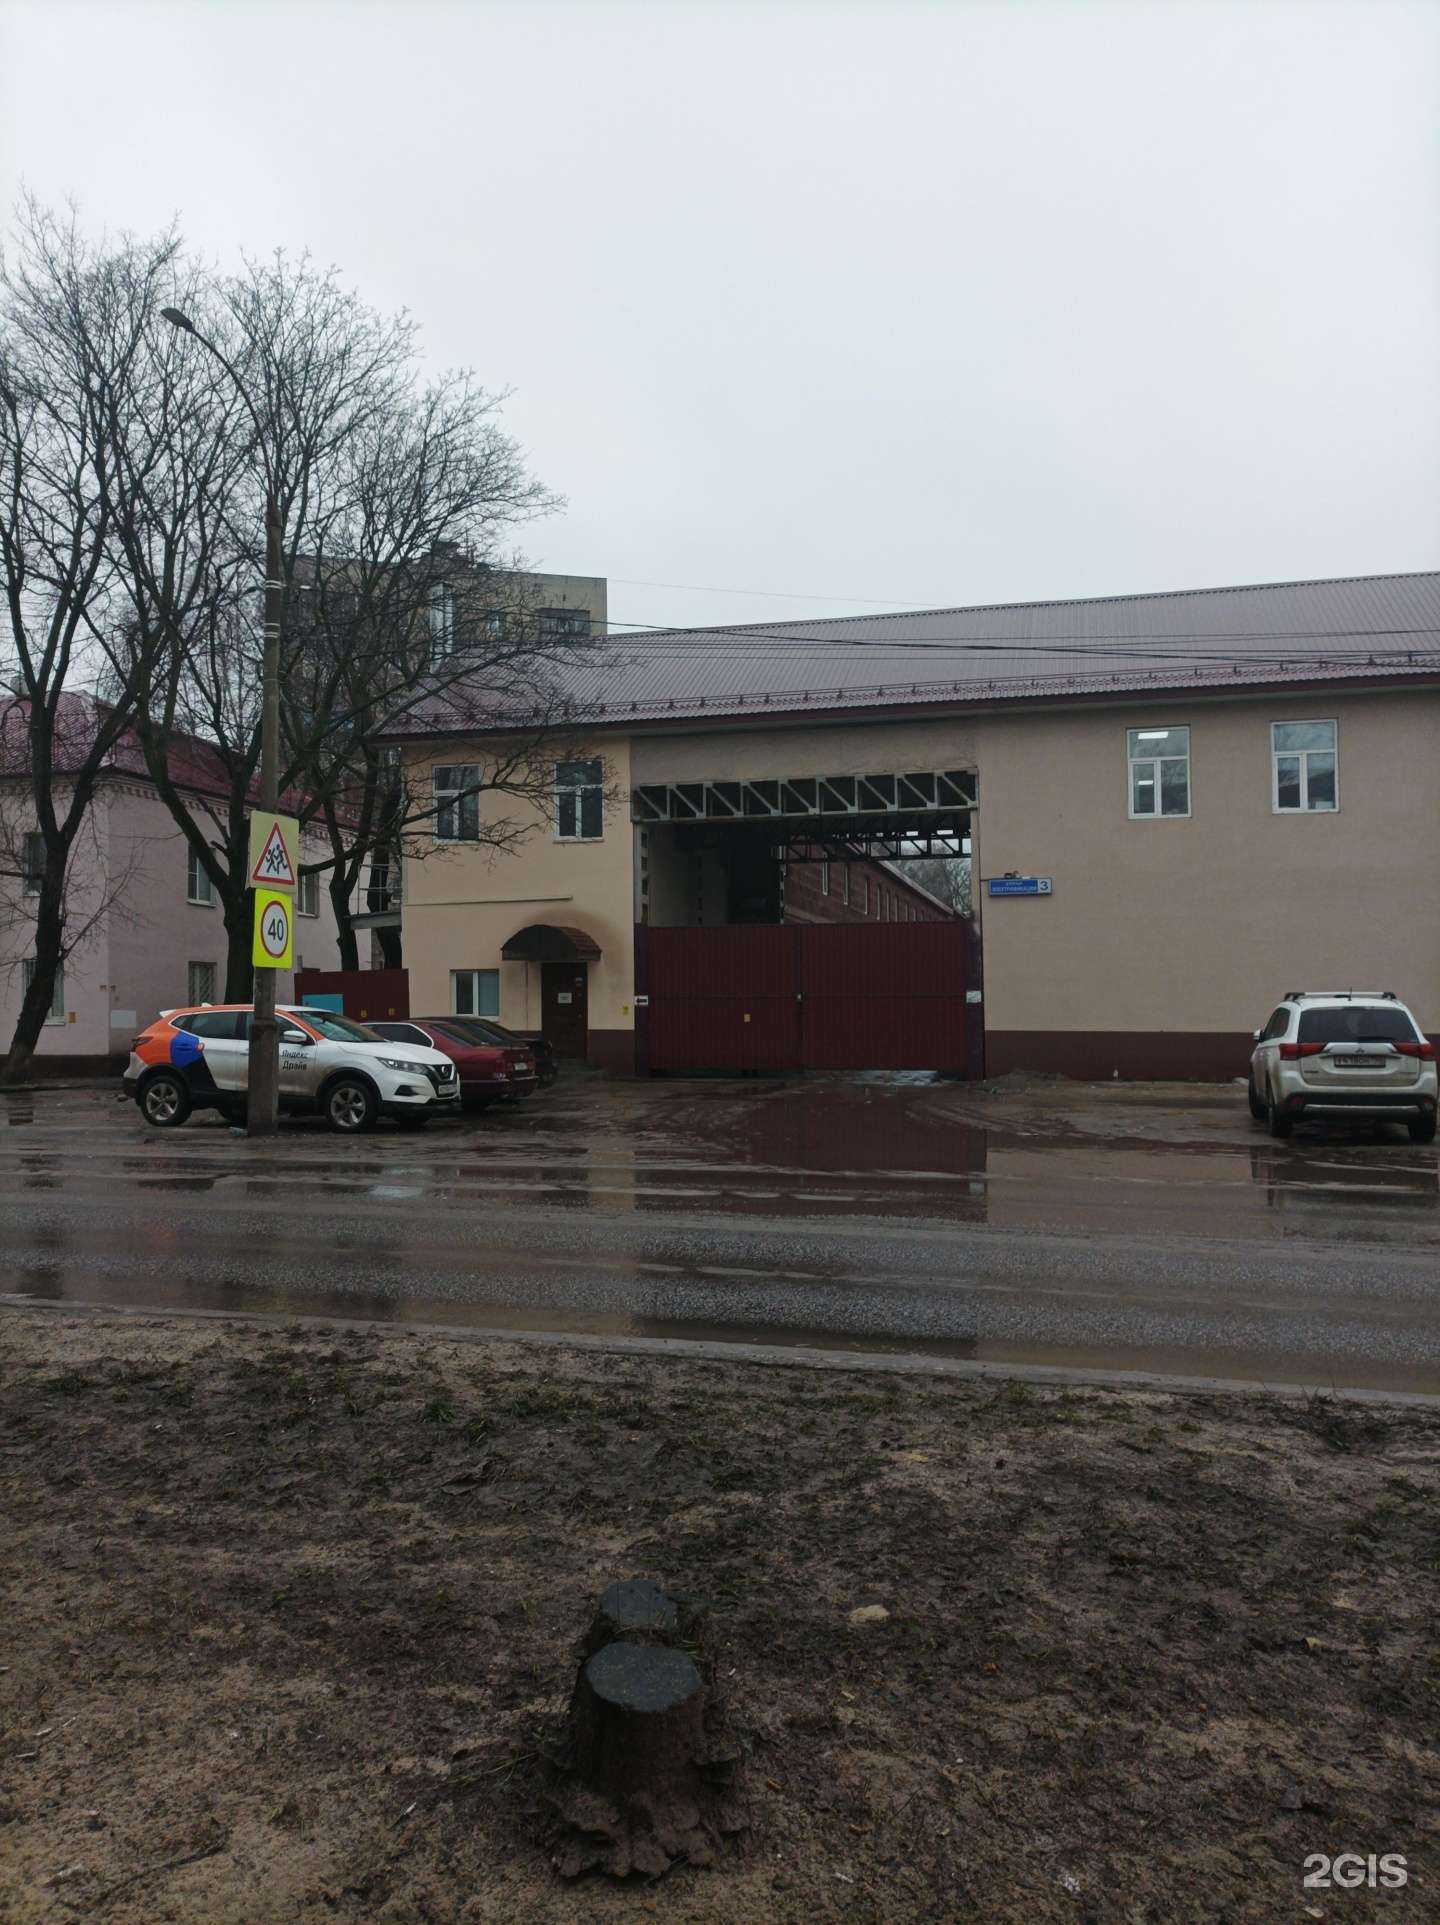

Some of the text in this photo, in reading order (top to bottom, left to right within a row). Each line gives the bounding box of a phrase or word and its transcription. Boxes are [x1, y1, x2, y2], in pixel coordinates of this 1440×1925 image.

[1040, 880, 1049, 891] 3
[267, 918, 284, 941] 40
[282, 1049, 309, 1059] Яндекс
[282, 1060, 307, 1071] Драйв
